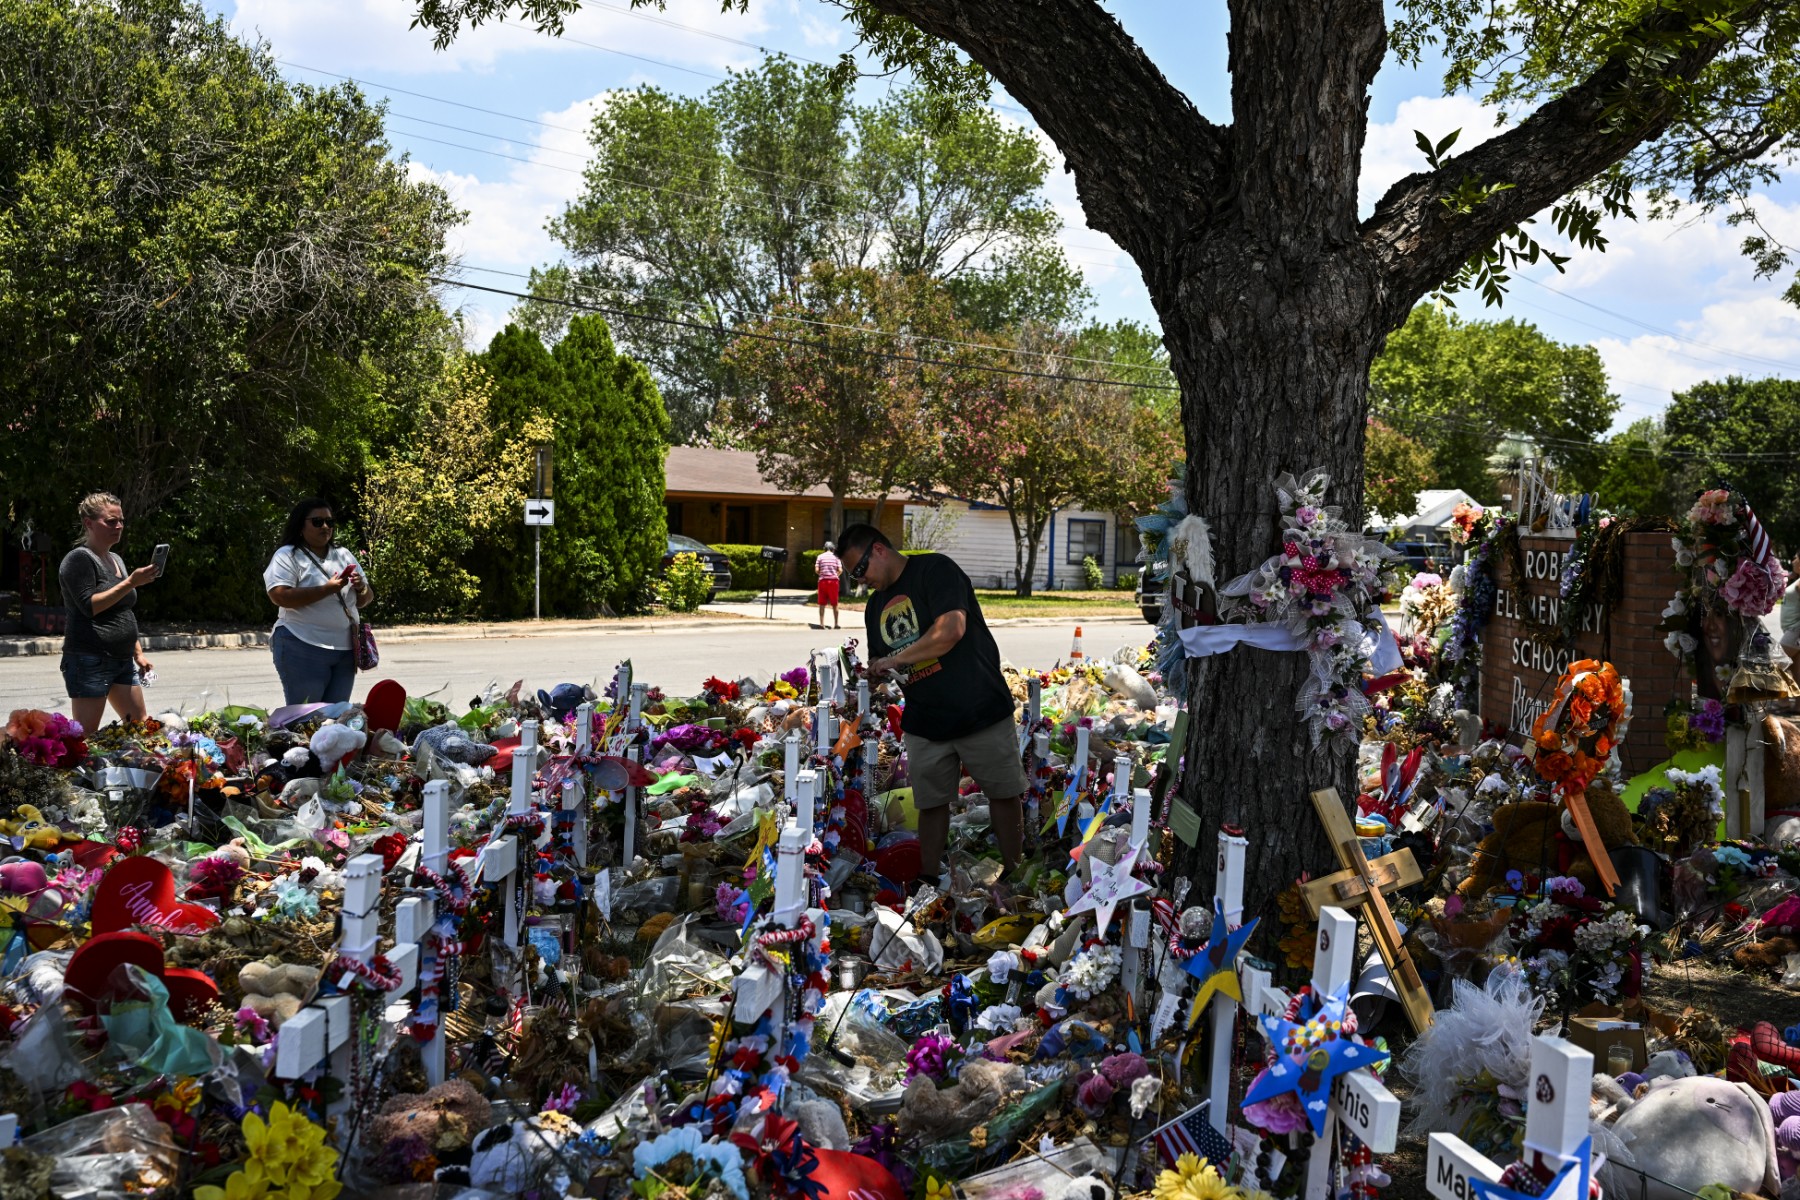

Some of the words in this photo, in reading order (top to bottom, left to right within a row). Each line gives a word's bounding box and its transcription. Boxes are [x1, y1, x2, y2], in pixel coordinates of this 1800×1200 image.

[1525, 550, 1566, 582] ROB
[1495, 589, 1604, 635] ELMENRY
[908, 667, 932, 684] GEND
